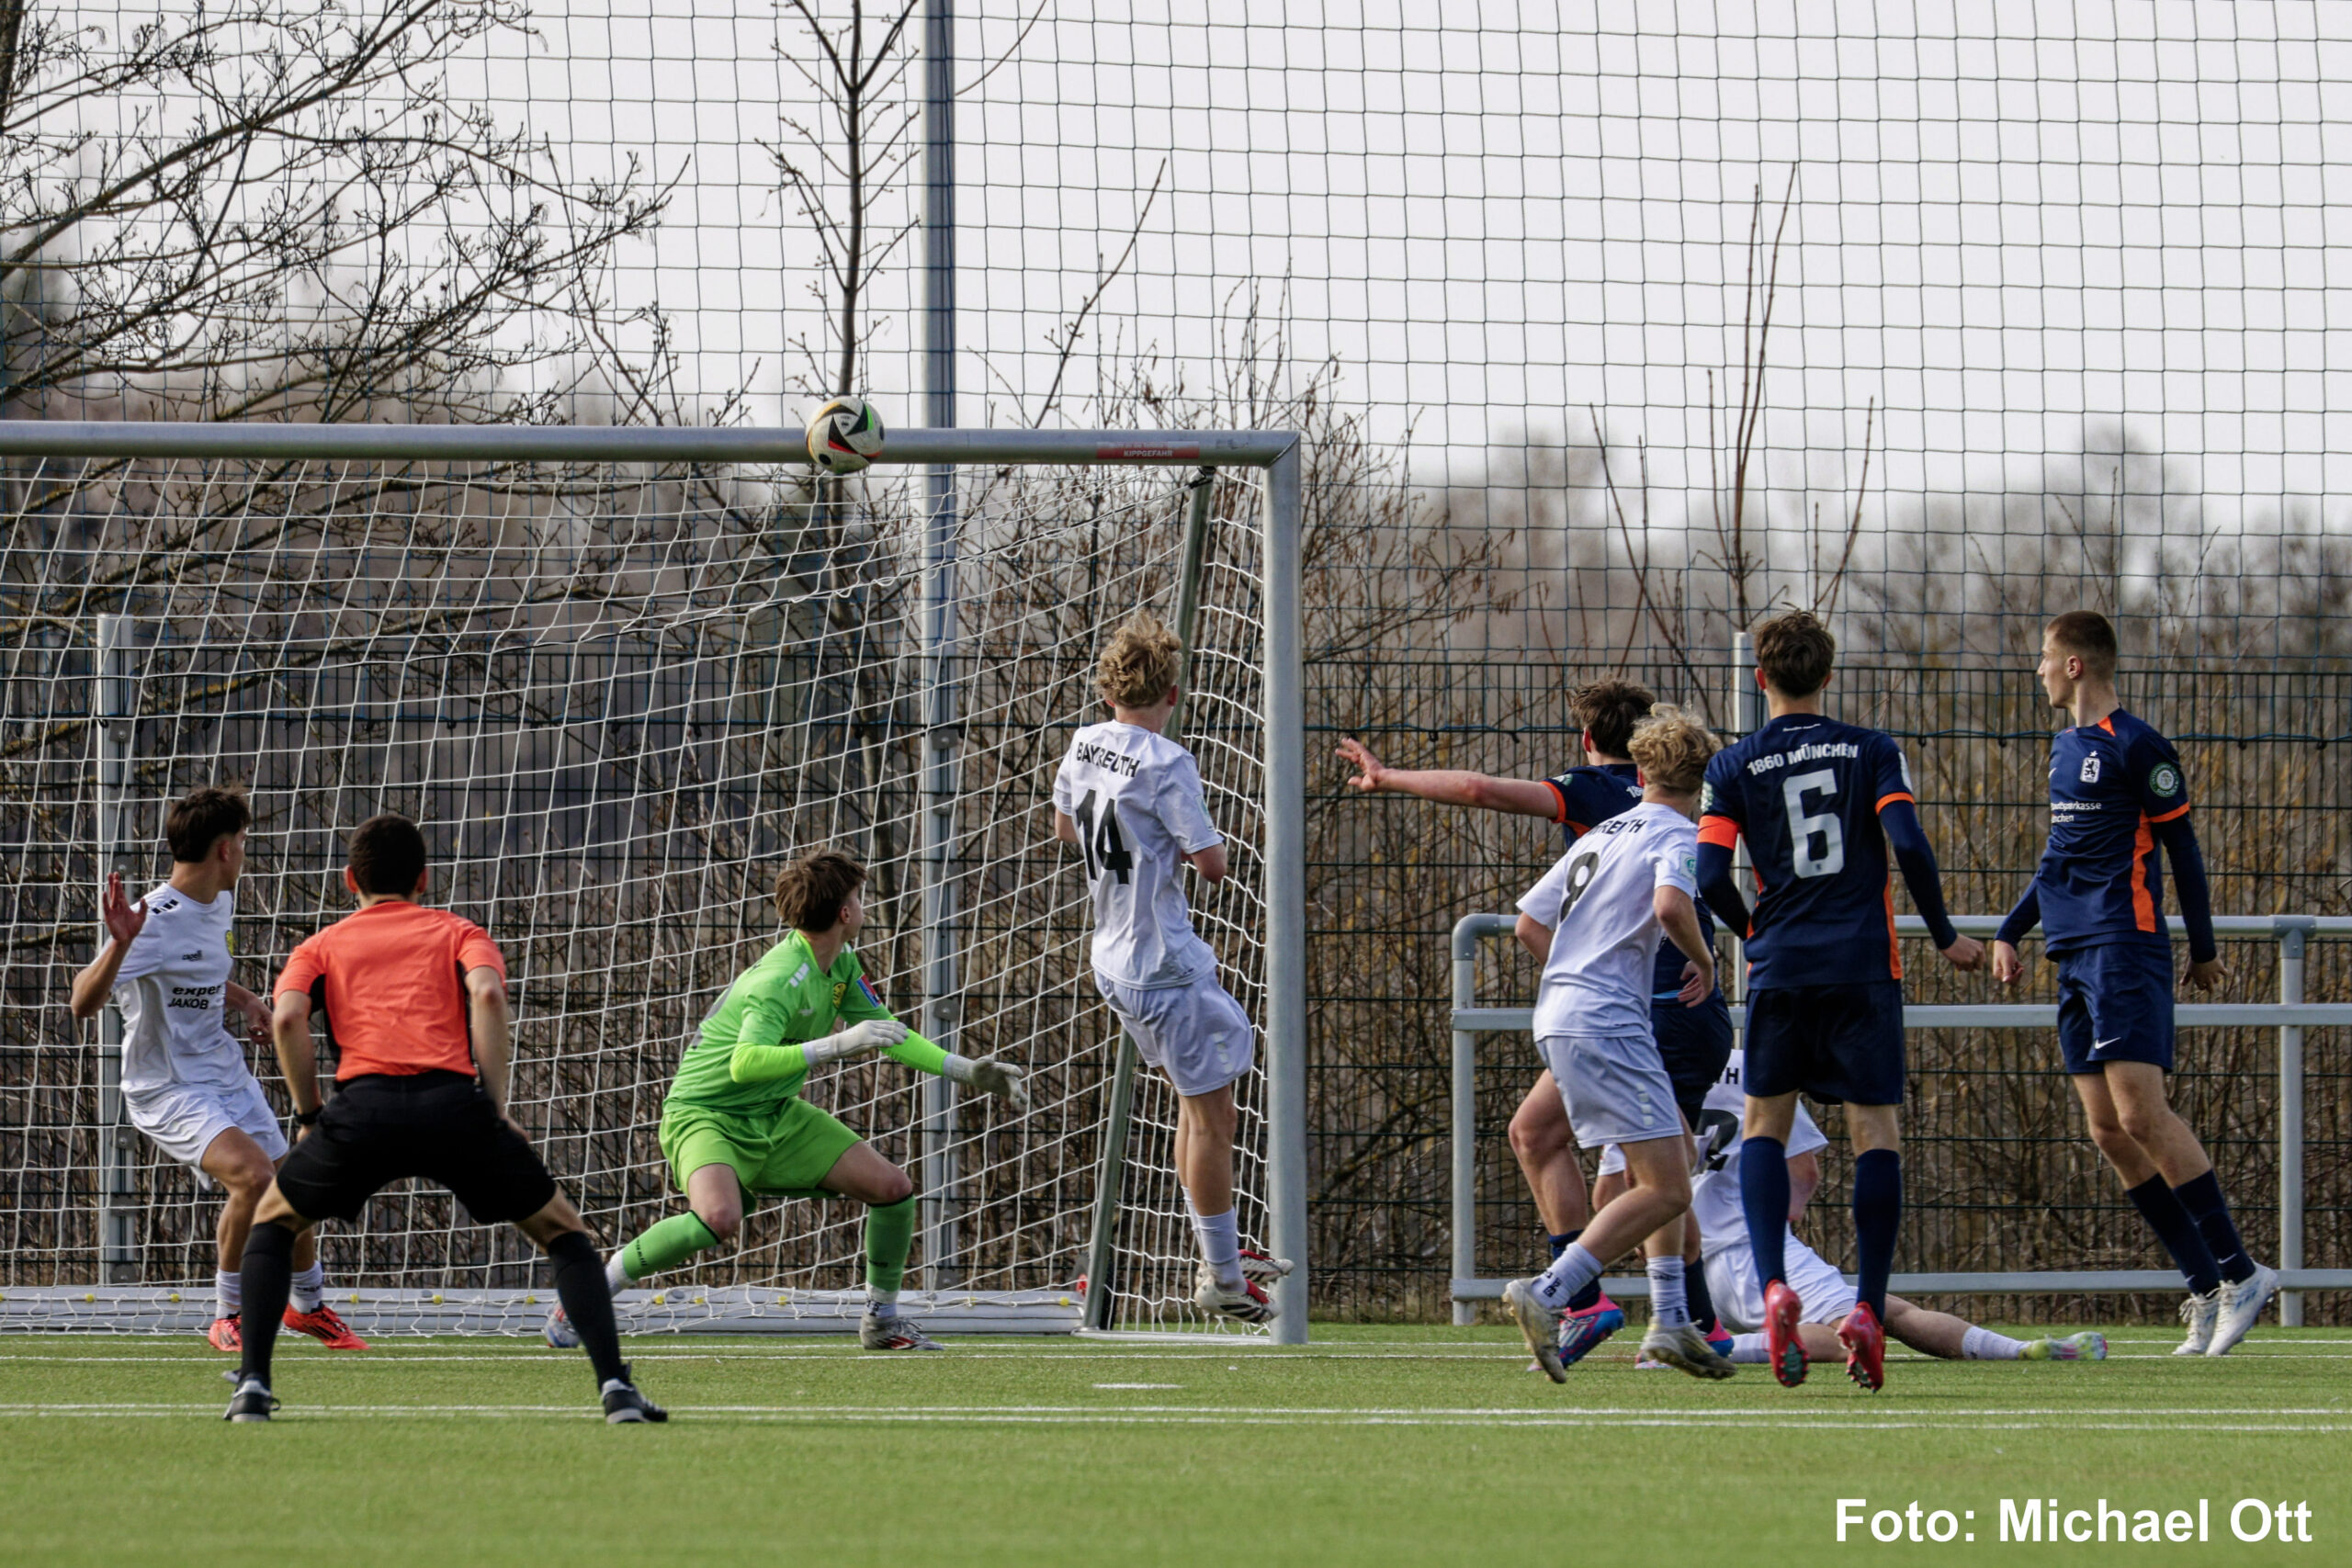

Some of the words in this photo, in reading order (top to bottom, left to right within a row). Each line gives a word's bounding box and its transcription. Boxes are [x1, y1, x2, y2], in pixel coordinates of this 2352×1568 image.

[1747, 754, 1785, 776] 1860
[1787, 742, 1859, 766] MÜNCHEN
[1076, 788, 1134, 885] 14
[1782, 768, 1845, 879] 6
[167, 998, 209, 1010] JAKOB
